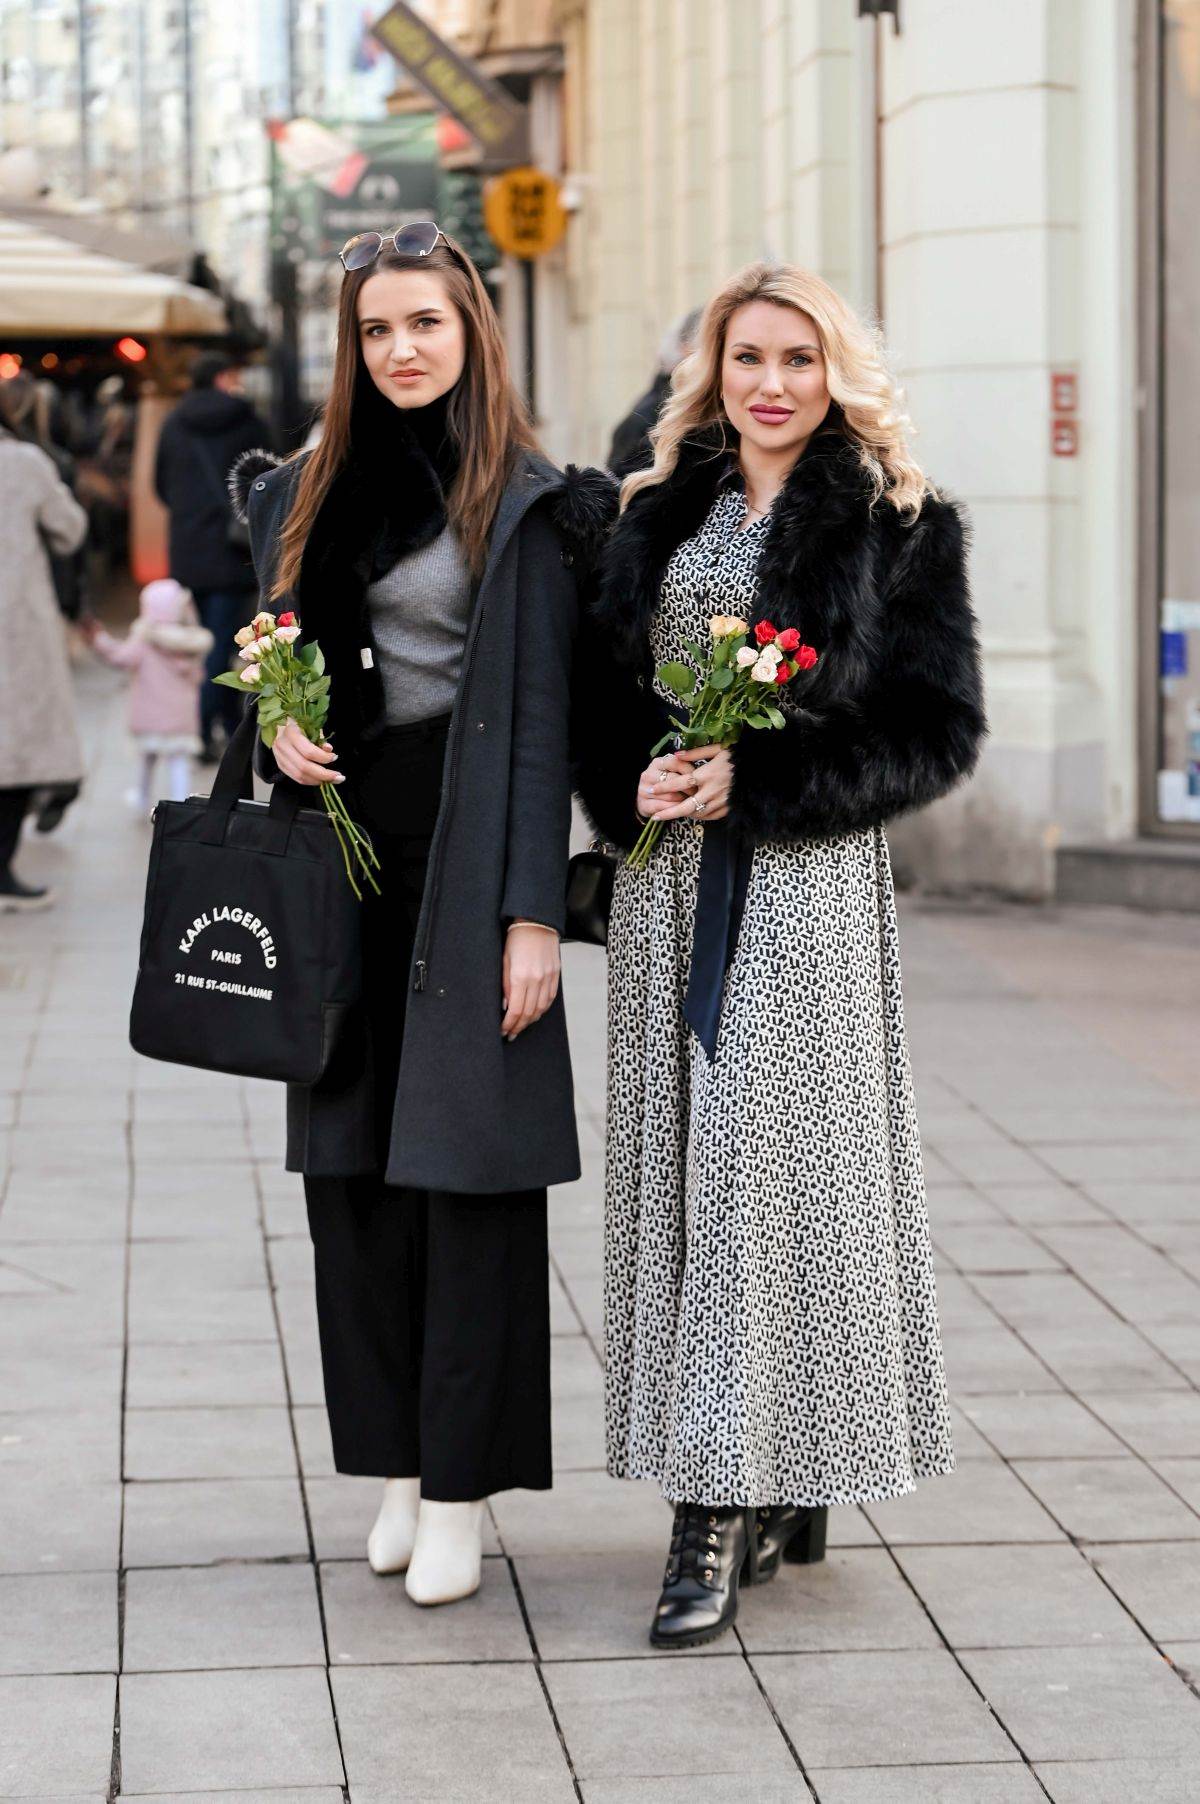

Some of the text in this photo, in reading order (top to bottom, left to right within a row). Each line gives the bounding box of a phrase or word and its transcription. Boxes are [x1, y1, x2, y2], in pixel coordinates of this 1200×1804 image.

[179, 906, 277, 969] KARL LAGERFELD
[211, 949, 242, 965] PARIS
[175, 973, 273, 1001] 21 RUE ST-GUILLAUME
